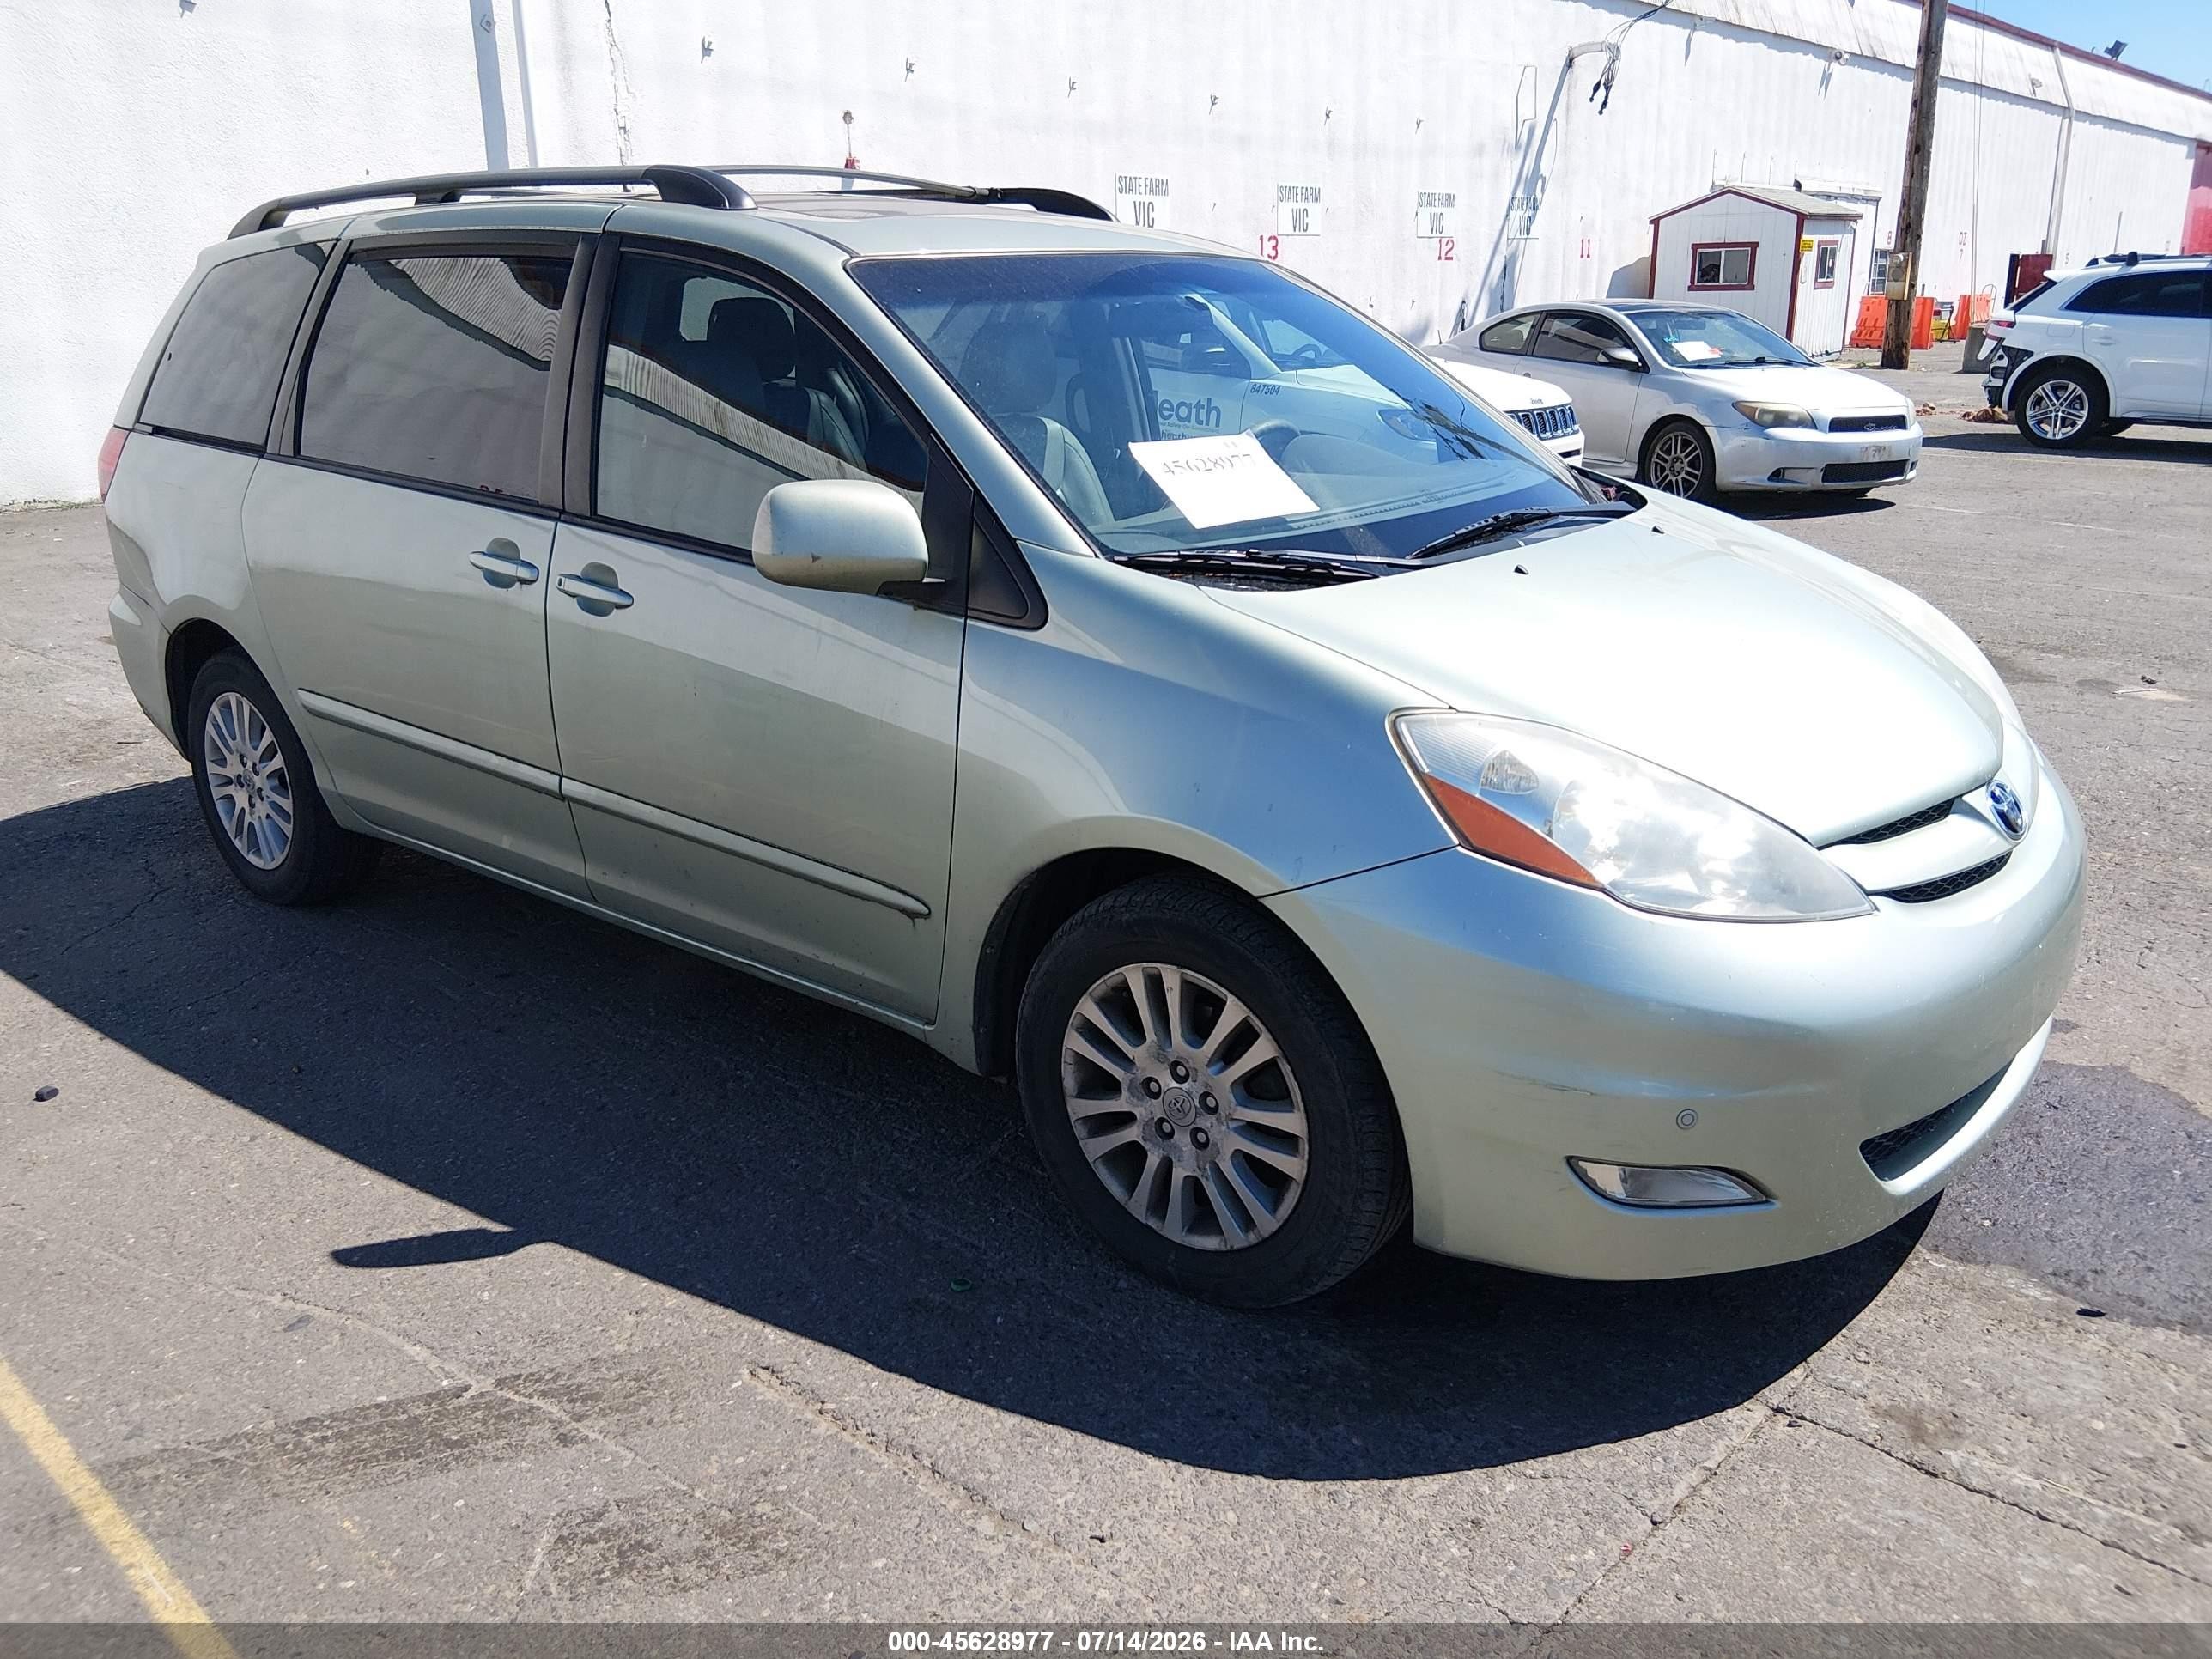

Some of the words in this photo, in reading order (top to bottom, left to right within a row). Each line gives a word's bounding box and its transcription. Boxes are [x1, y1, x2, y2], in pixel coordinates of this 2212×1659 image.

[1118, 175, 1142, 195] STATE
[1145, 178, 1169, 197] FARM
[1279, 185, 1298, 203] STATE
[1301, 186, 1321, 204] FARM
[1419, 191, 1437, 208] STATE
[1438, 193, 1455, 208] FARM
[1133, 201, 1154, 228] VIC
[1291, 208, 1309, 232] VIC
[1430, 212, 1443, 234] VIC
[1259, 234, 1279, 260] 13
[1437, 238, 1455, 261] 12
[1580, 239, 1590, 258] 11
[1250, 383, 1281, 396] 847504
[1153, 390, 1222, 428] eath
